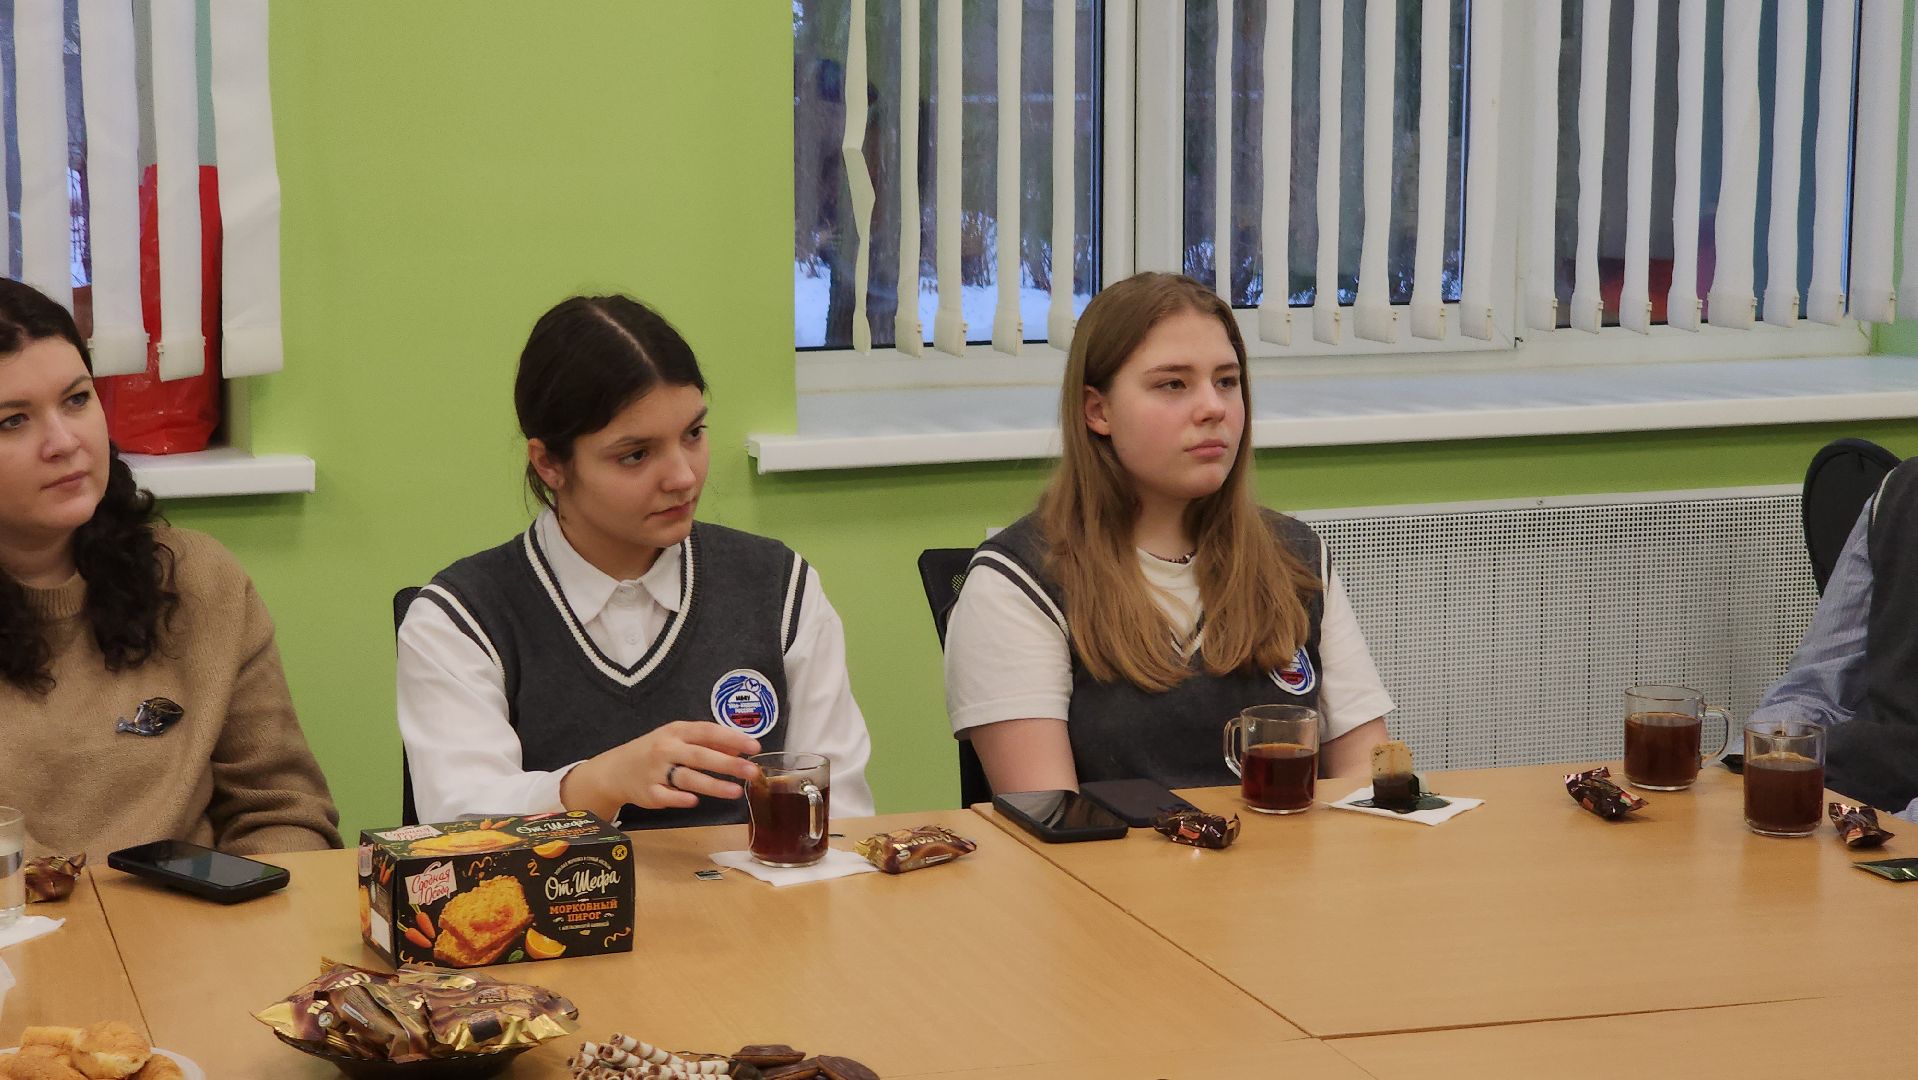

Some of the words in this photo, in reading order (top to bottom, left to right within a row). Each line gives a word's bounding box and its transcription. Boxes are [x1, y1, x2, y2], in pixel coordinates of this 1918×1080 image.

[545, 876, 574, 900] От
[572, 869, 621, 897] Шефа
[549, 900, 618, 915] МОРКОВНЫЙ
[568, 911, 602, 922] ПИРОГ
